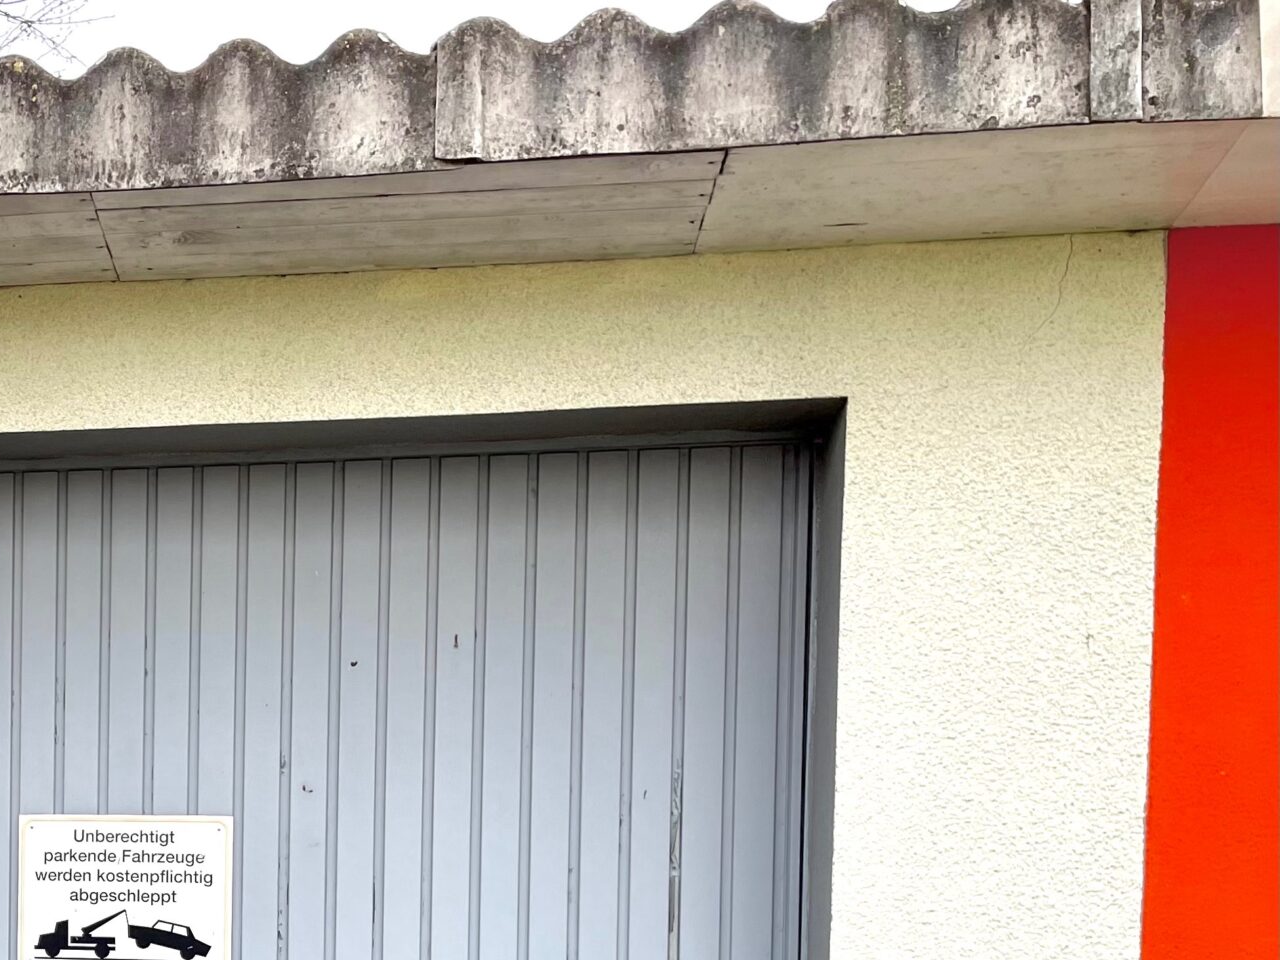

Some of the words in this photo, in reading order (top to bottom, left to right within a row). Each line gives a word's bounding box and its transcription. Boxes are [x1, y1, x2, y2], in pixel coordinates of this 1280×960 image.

[73, 829, 175, 846] Unberechtigt
[44, 849, 117, 864] parkende
[122, 850, 205, 867] Fahrzeuge
[35, 869, 92, 882] werden
[97, 870, 213, 887] kostenpflichtig
[70, 889, 177, 906] abgeschleppt
